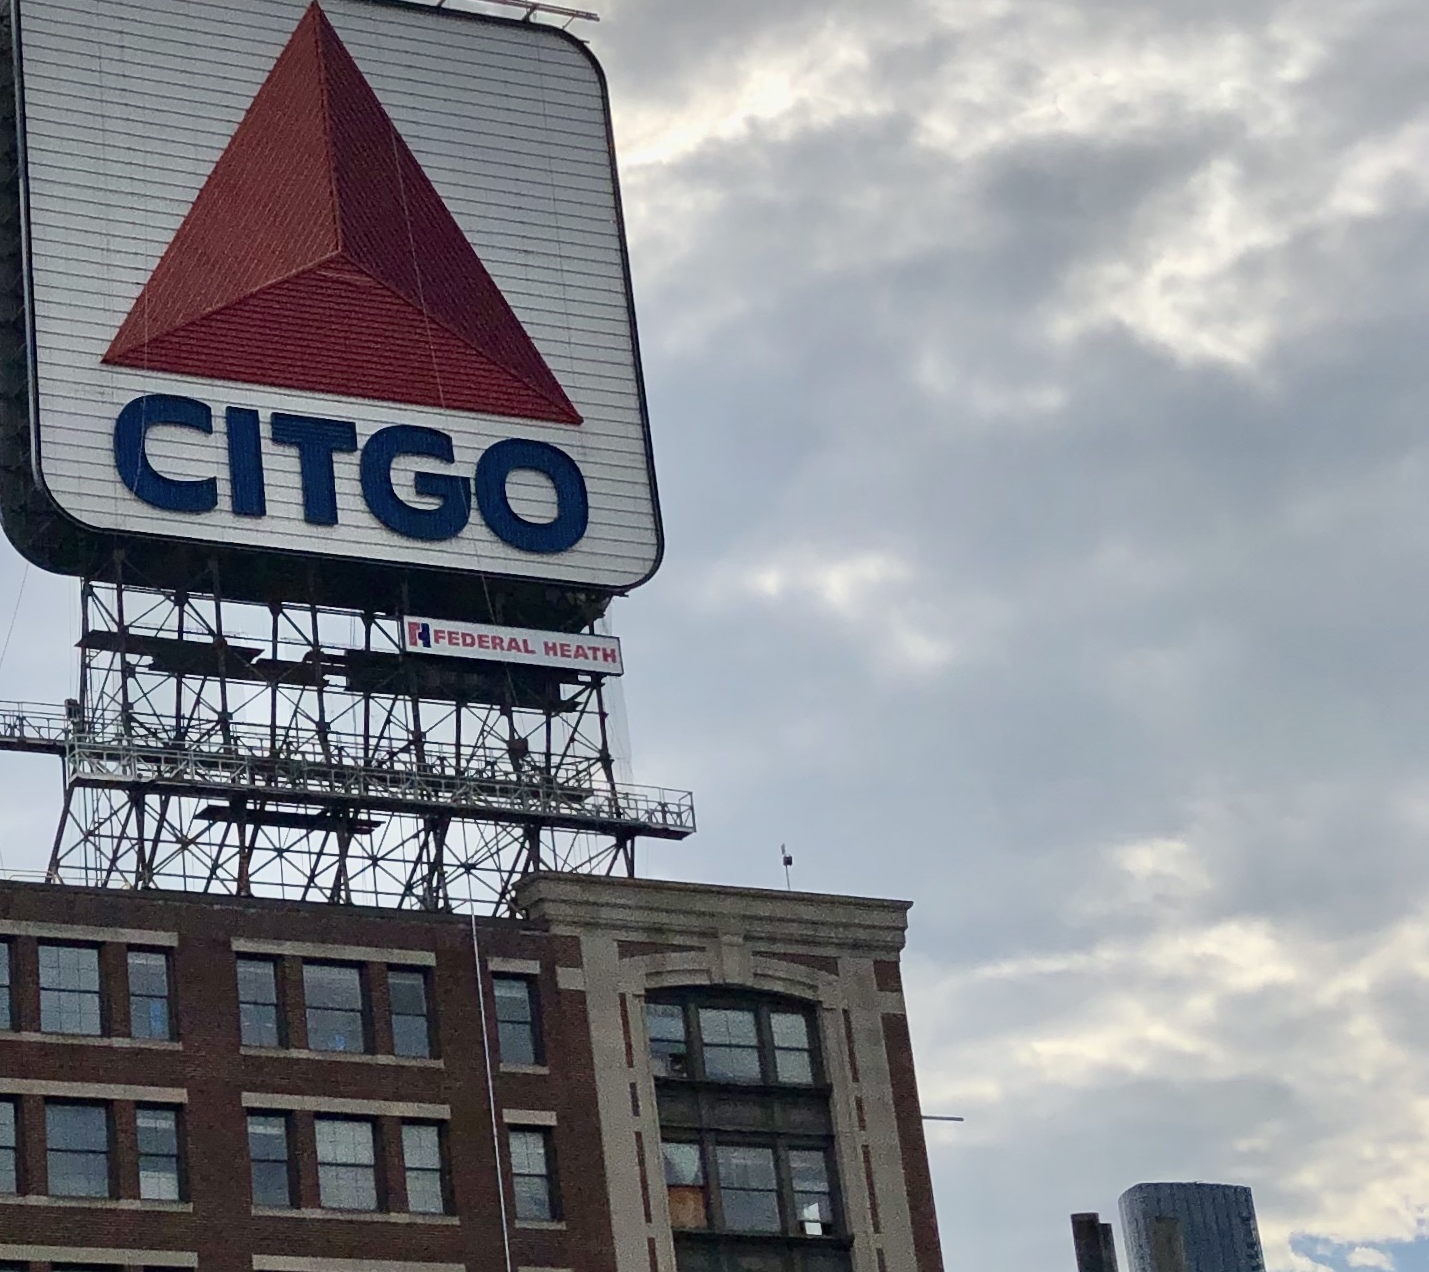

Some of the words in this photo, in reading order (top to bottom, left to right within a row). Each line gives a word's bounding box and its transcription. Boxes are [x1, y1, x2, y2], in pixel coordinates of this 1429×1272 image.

[113, 393, 589, 554] CITGO
[433, 628, 537, 655] FEDERAL
[543, 640, 617, 664] HEATH
